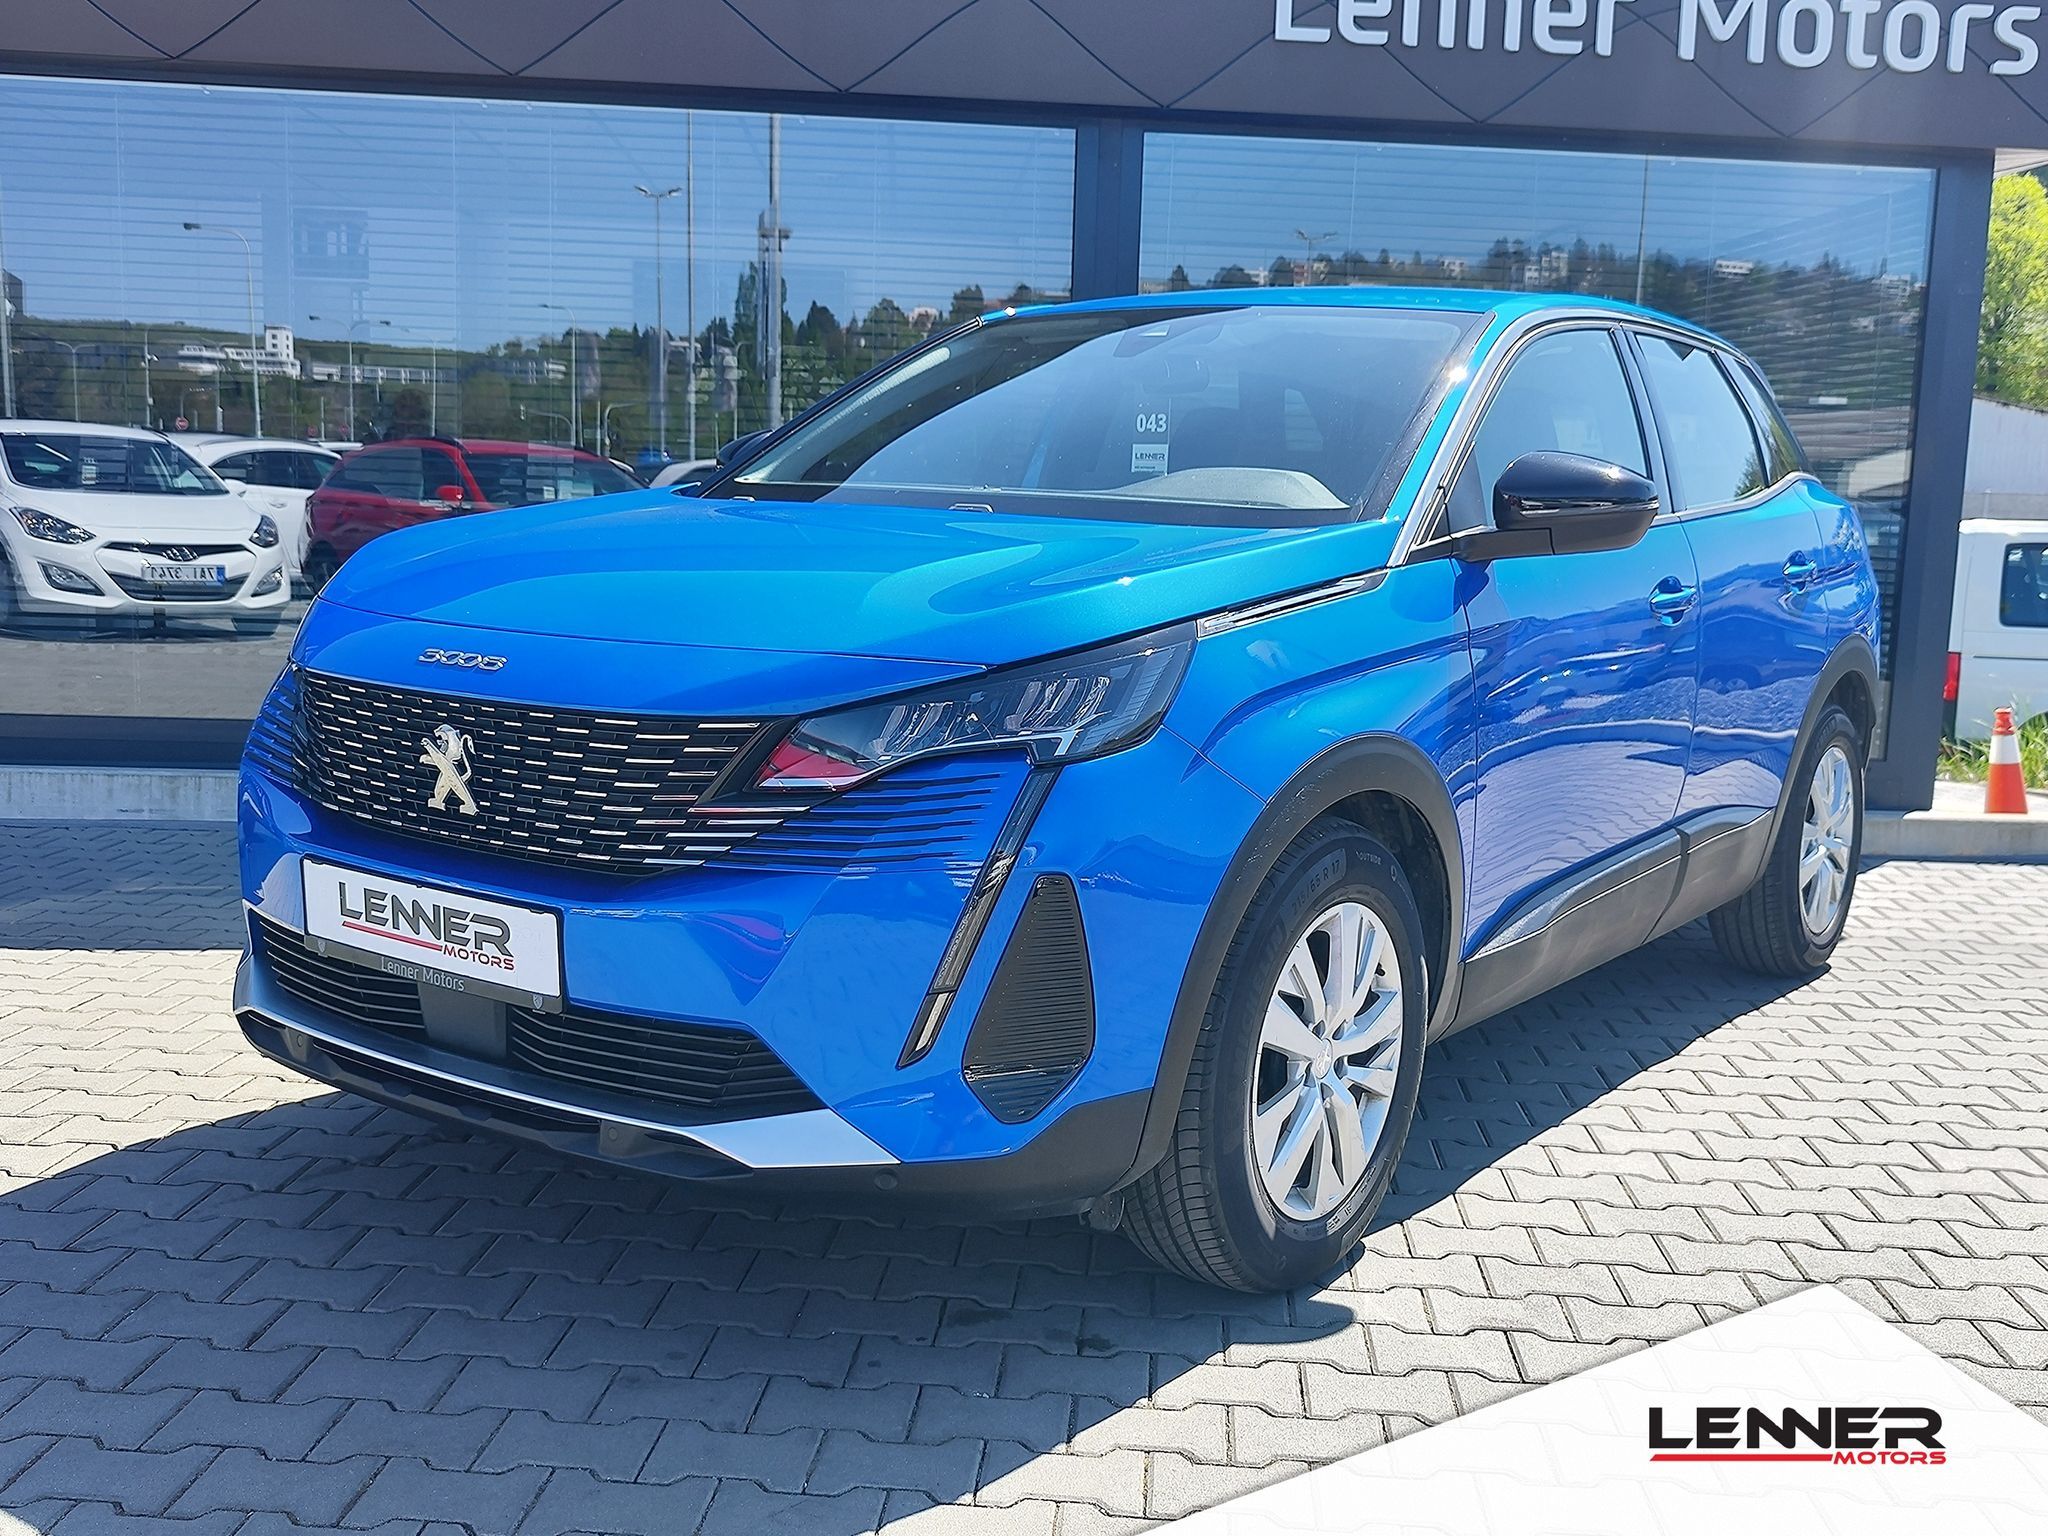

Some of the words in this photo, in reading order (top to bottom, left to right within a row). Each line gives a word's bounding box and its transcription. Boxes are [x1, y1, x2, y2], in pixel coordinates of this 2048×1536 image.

[1677, 0, 2042, 76] Motors
[1136, 413, 1167, 432] 043
[339, 881, 514, 957] LENNER
[381, 957, 418, 979] Lenner
[423, 969, 465, 991] Motors
[442, 944, 516, 971] MOTORS
